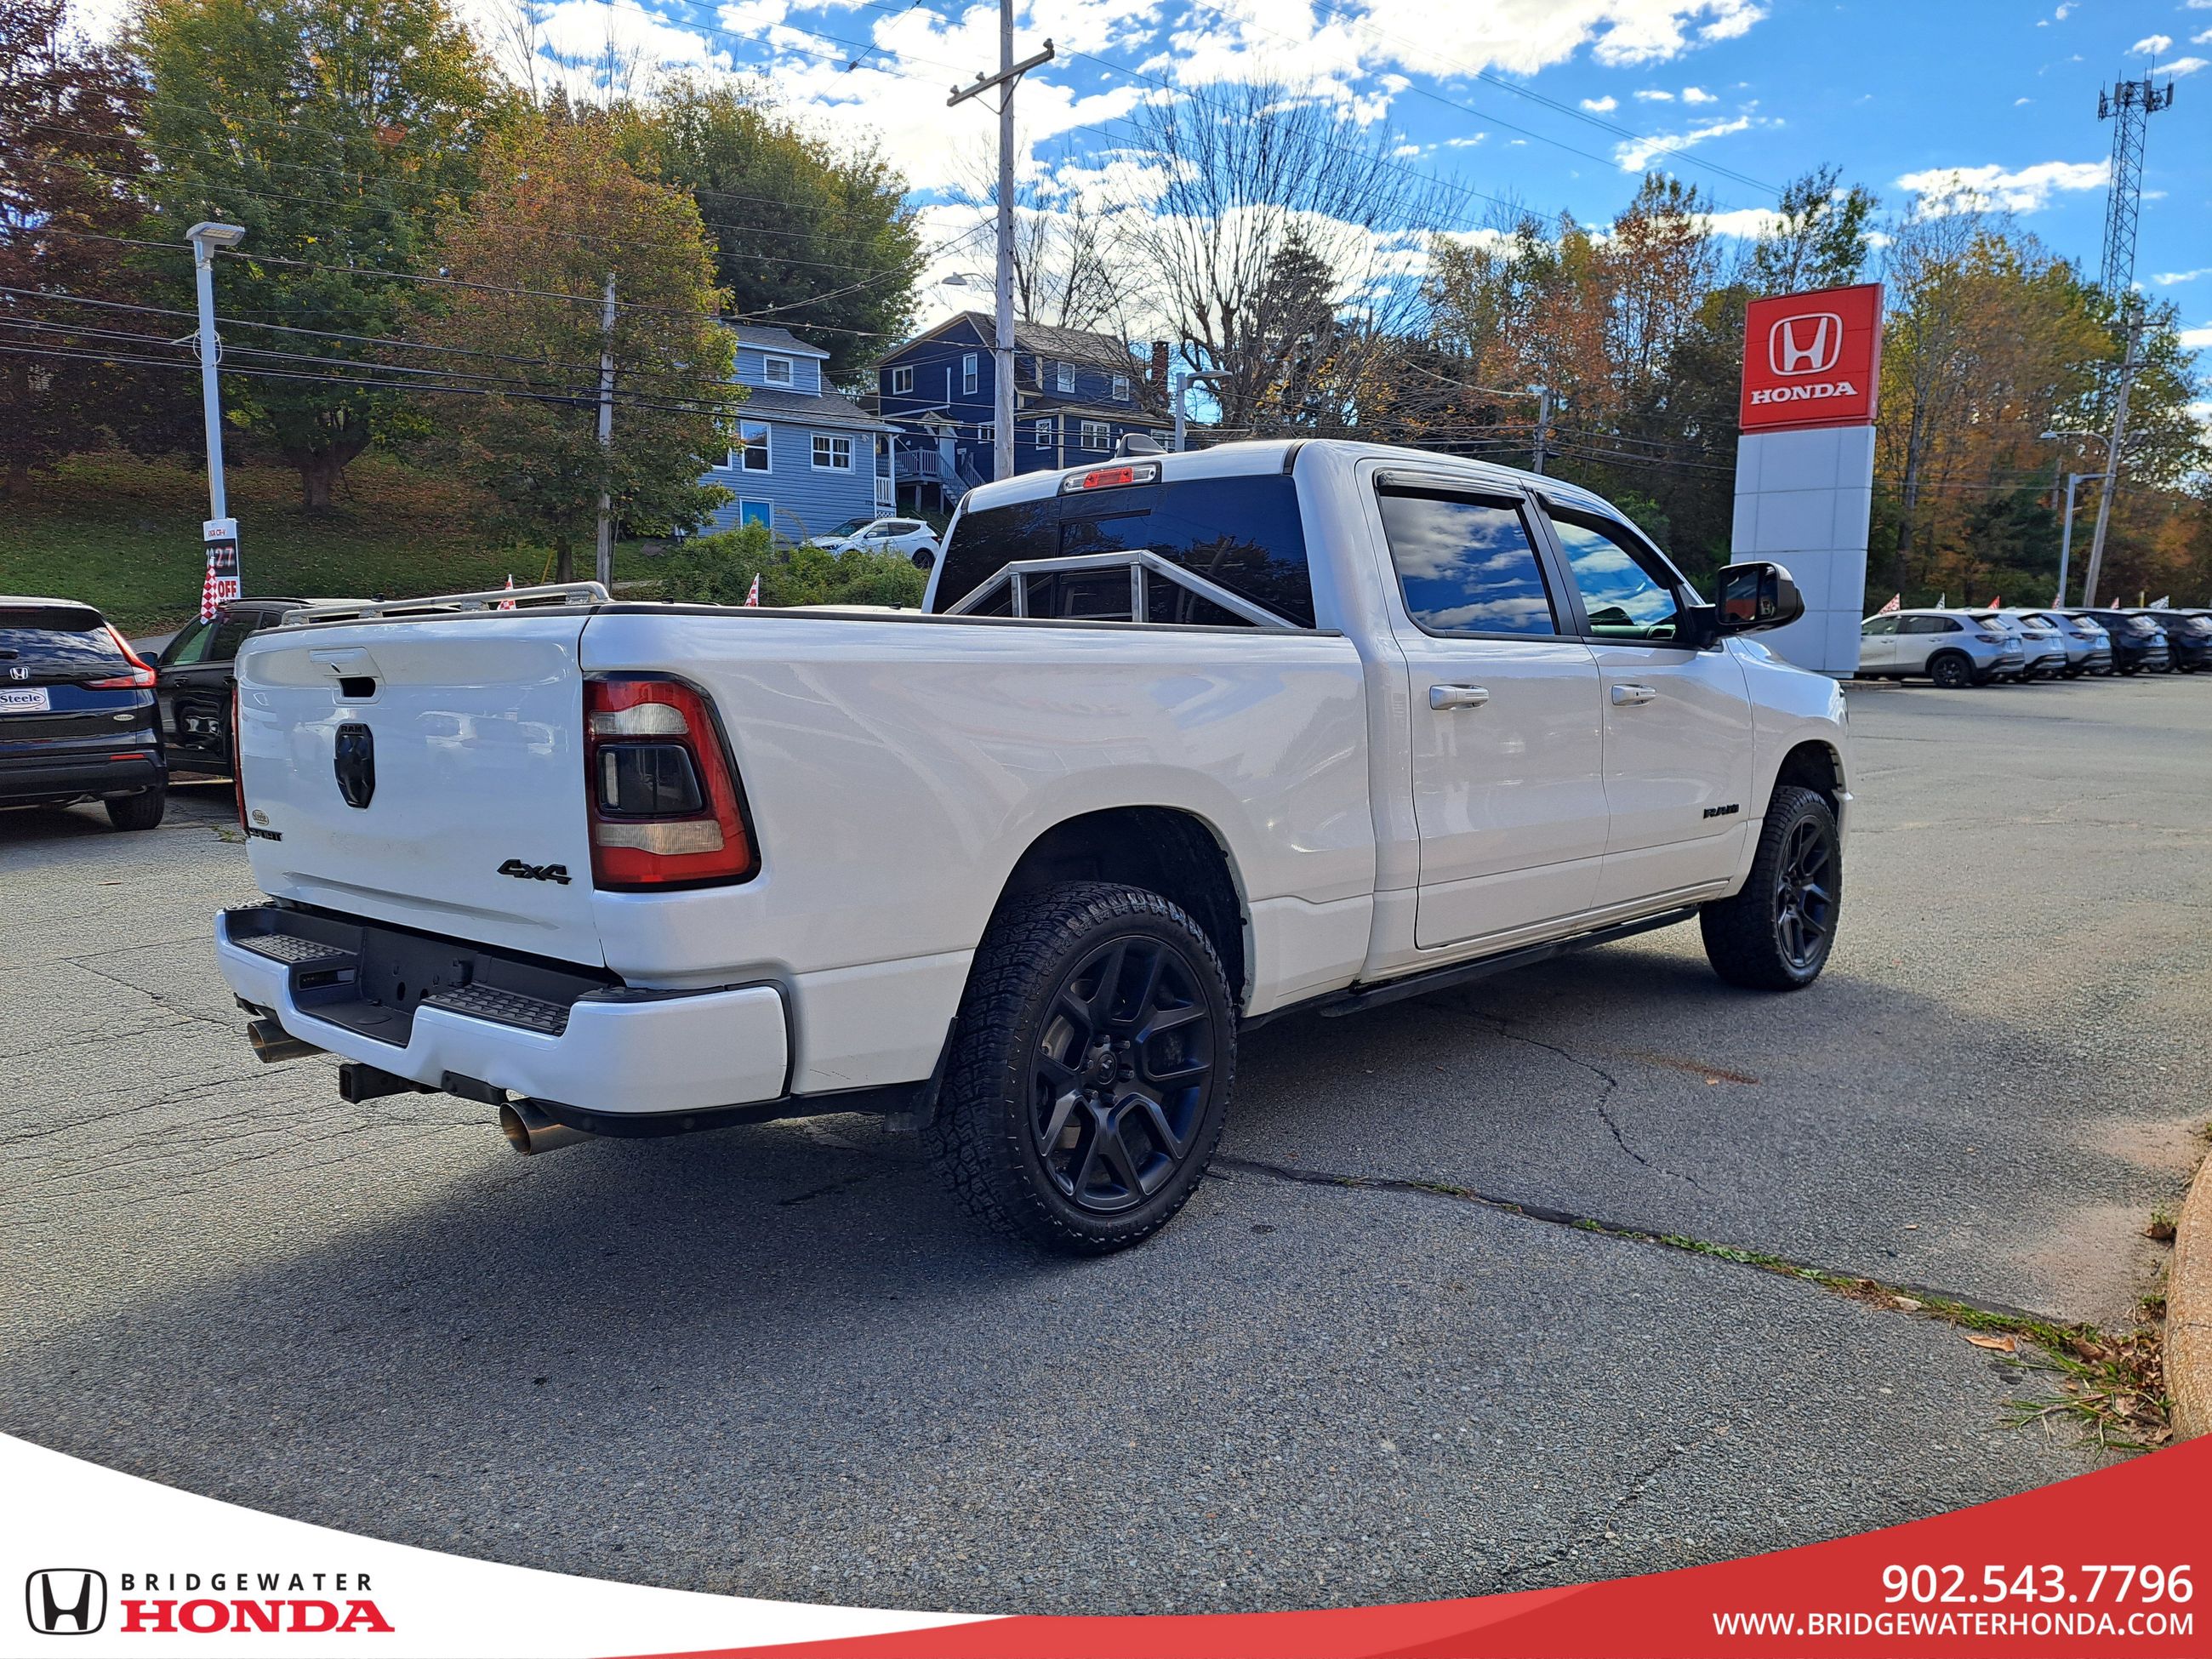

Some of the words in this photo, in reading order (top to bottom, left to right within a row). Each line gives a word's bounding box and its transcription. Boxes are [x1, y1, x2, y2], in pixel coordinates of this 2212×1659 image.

[1750, 380, 1858, 405] HONDA
[218, 580, 237, 598] OFF
[0, 693, 41, 704] Steele
